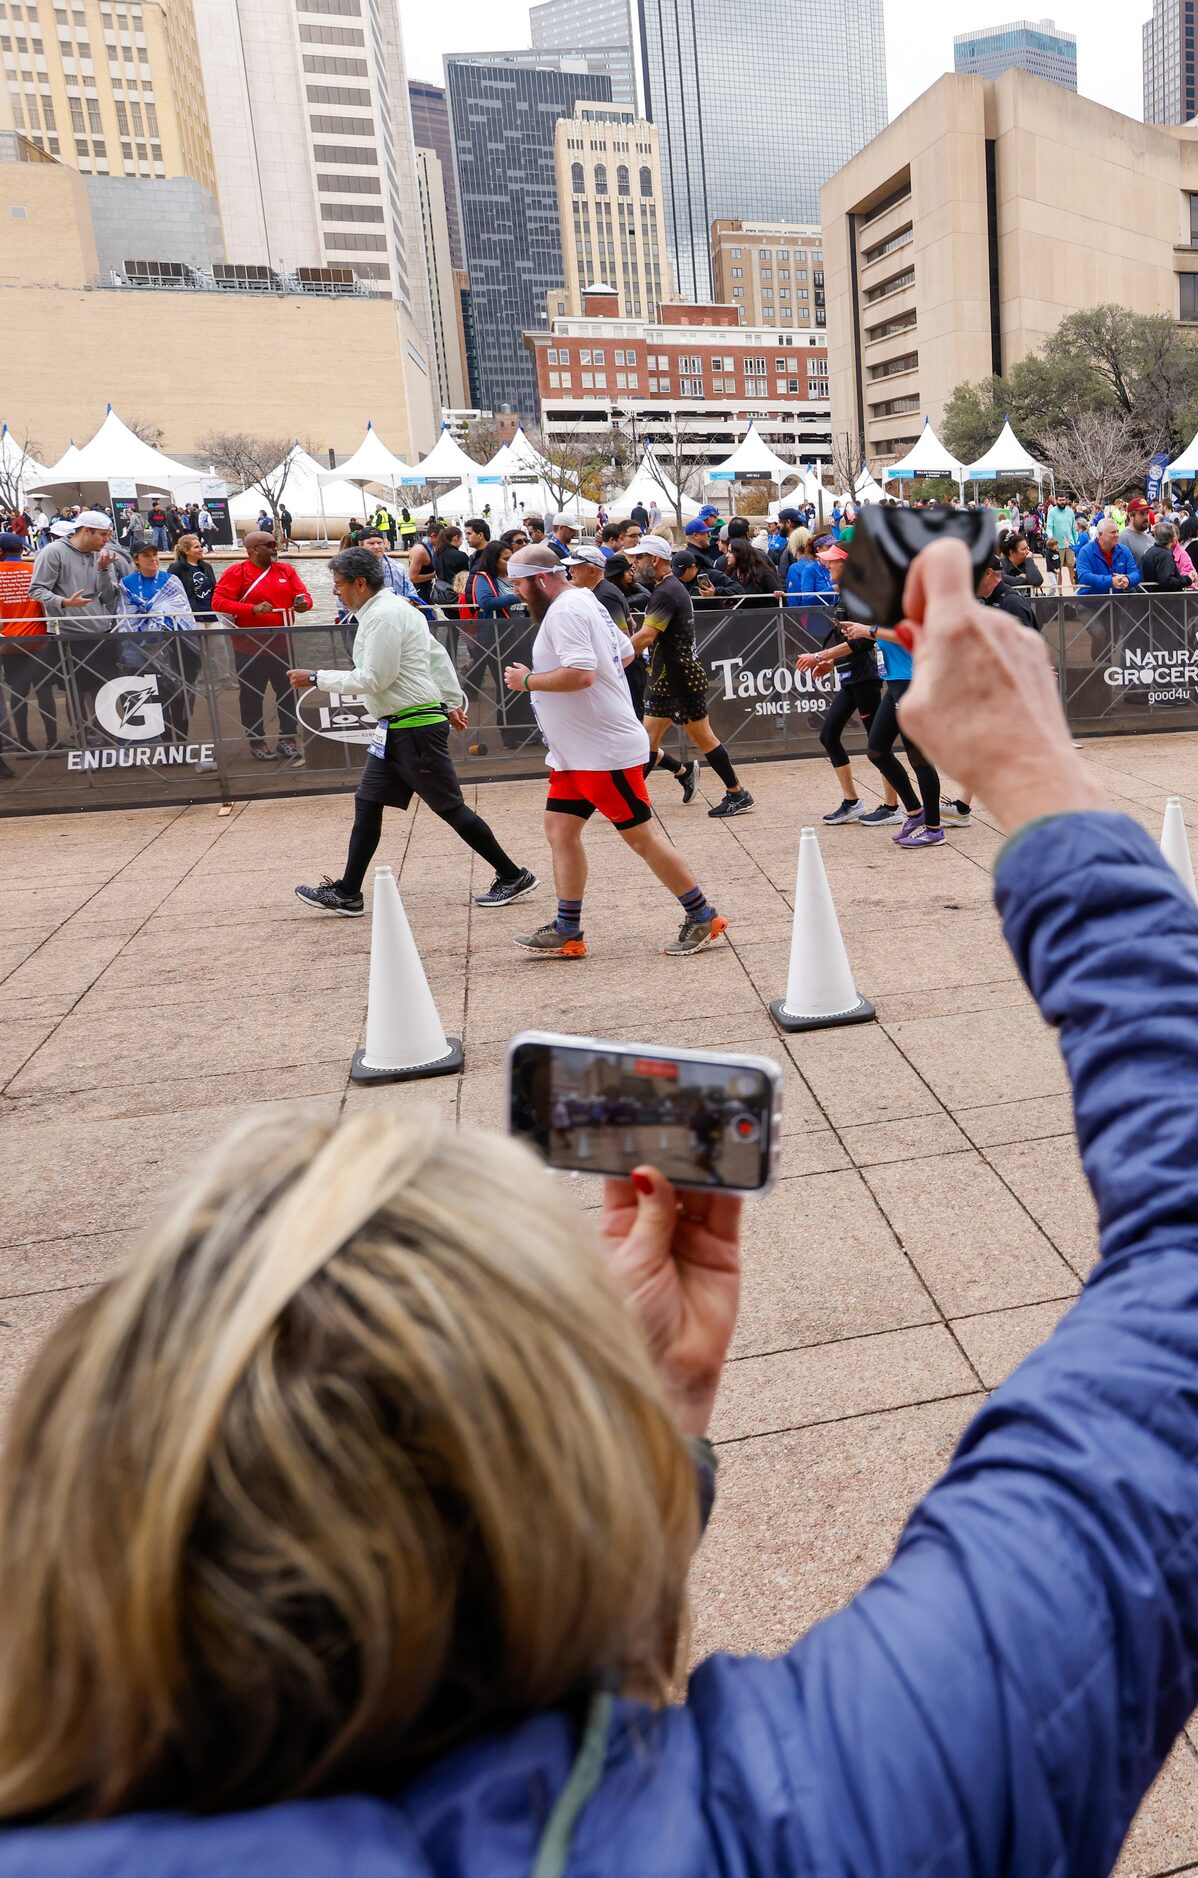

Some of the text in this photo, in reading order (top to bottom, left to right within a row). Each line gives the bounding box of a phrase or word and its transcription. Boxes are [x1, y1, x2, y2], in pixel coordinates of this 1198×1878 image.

[1147, 688, 1191, 705] good4u
[755, 698, 826, 716] SINCE 1999
[67, 743, 215, 770] ENDURANCE
